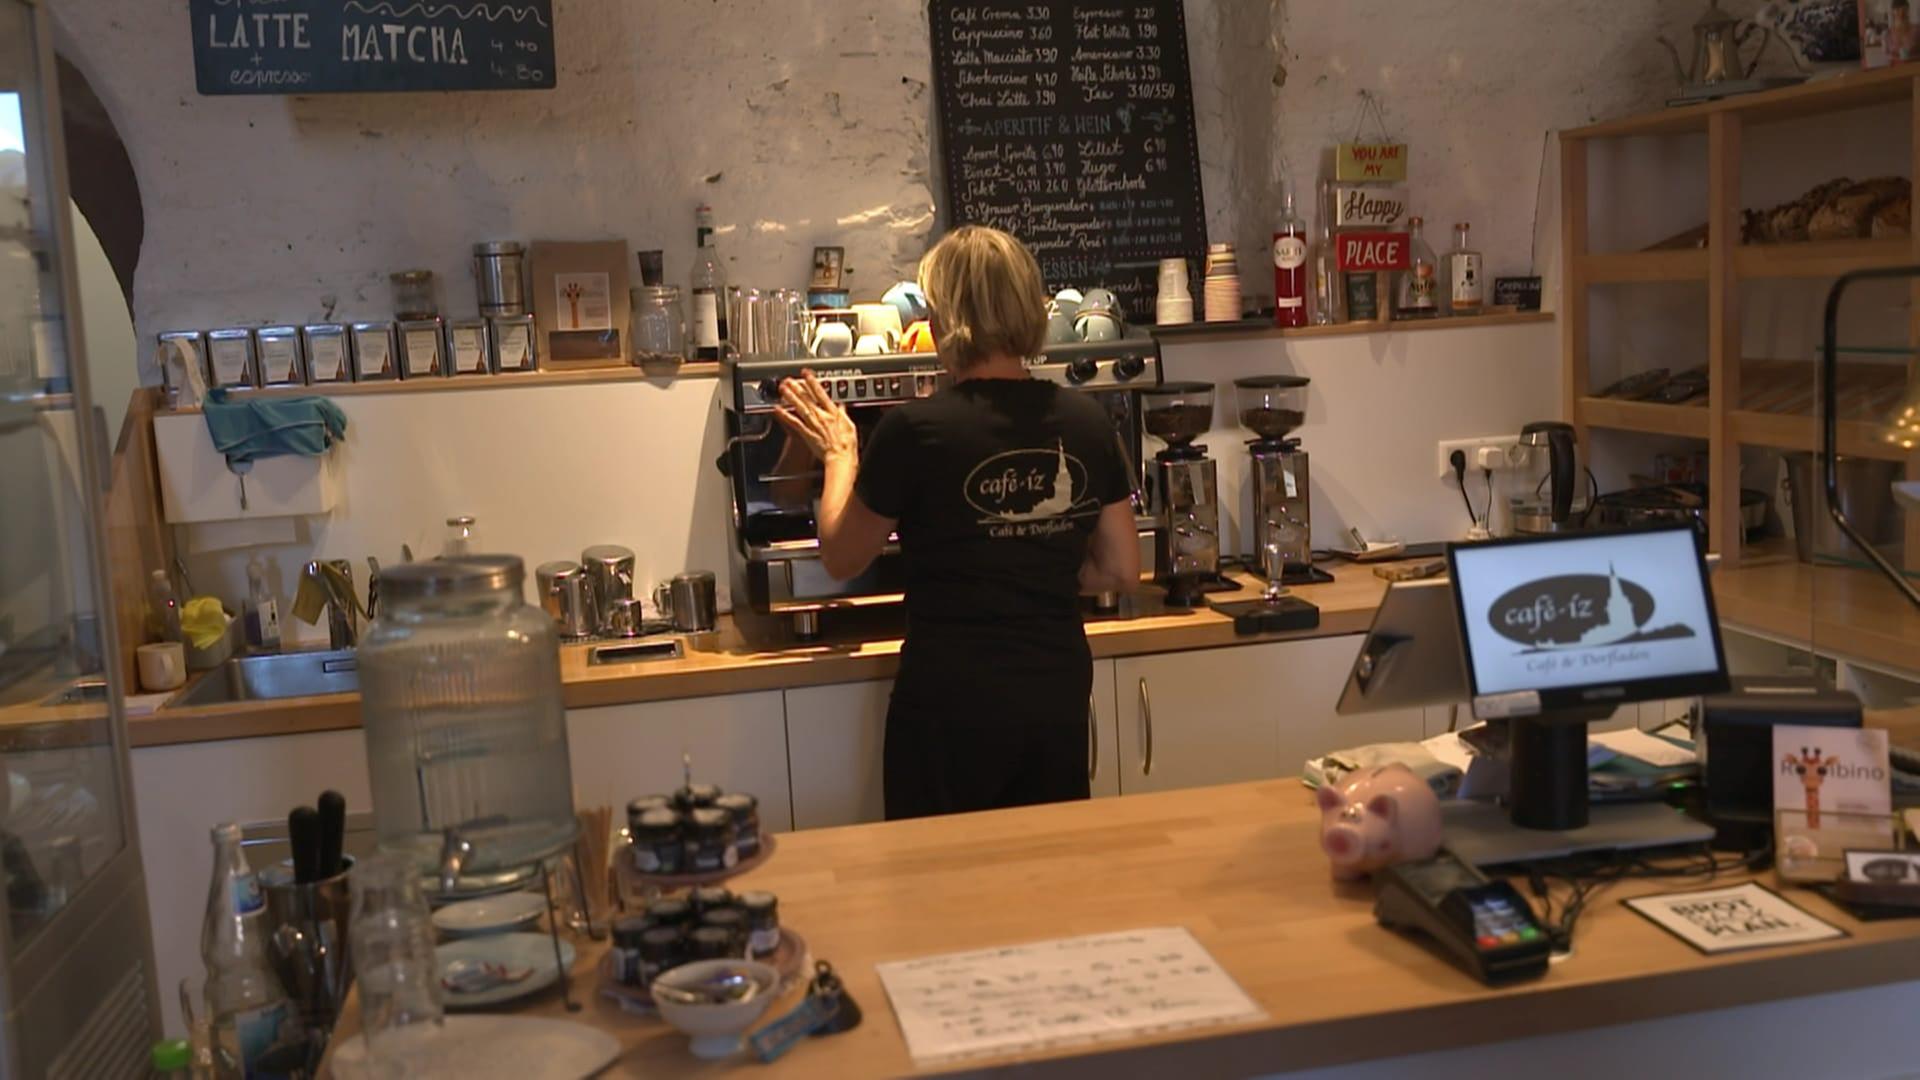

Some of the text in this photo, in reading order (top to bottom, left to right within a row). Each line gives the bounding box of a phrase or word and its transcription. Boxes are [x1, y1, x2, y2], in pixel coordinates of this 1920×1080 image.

[209, 13, 311, 48] LATTE
[952, 25, 1024, 47] Cappuccino
[342, 24, 468, 65] MATCHA
[982, 116, 1053, 138] APERITIF
[1352, 146, 1377, 161] YOU
[1364, 163, 1384, 177] MY
[1344, 190, 1404, 223] Happy
[1345, 240, 1399, 266] PLACE
[1042, 260, 1088, 279] ESSEN
[989, 524, 1014, 537] Café
[1016, 525, 1027, 536] &
[1526, 648, 1650, 673] Café & Dorfladen
